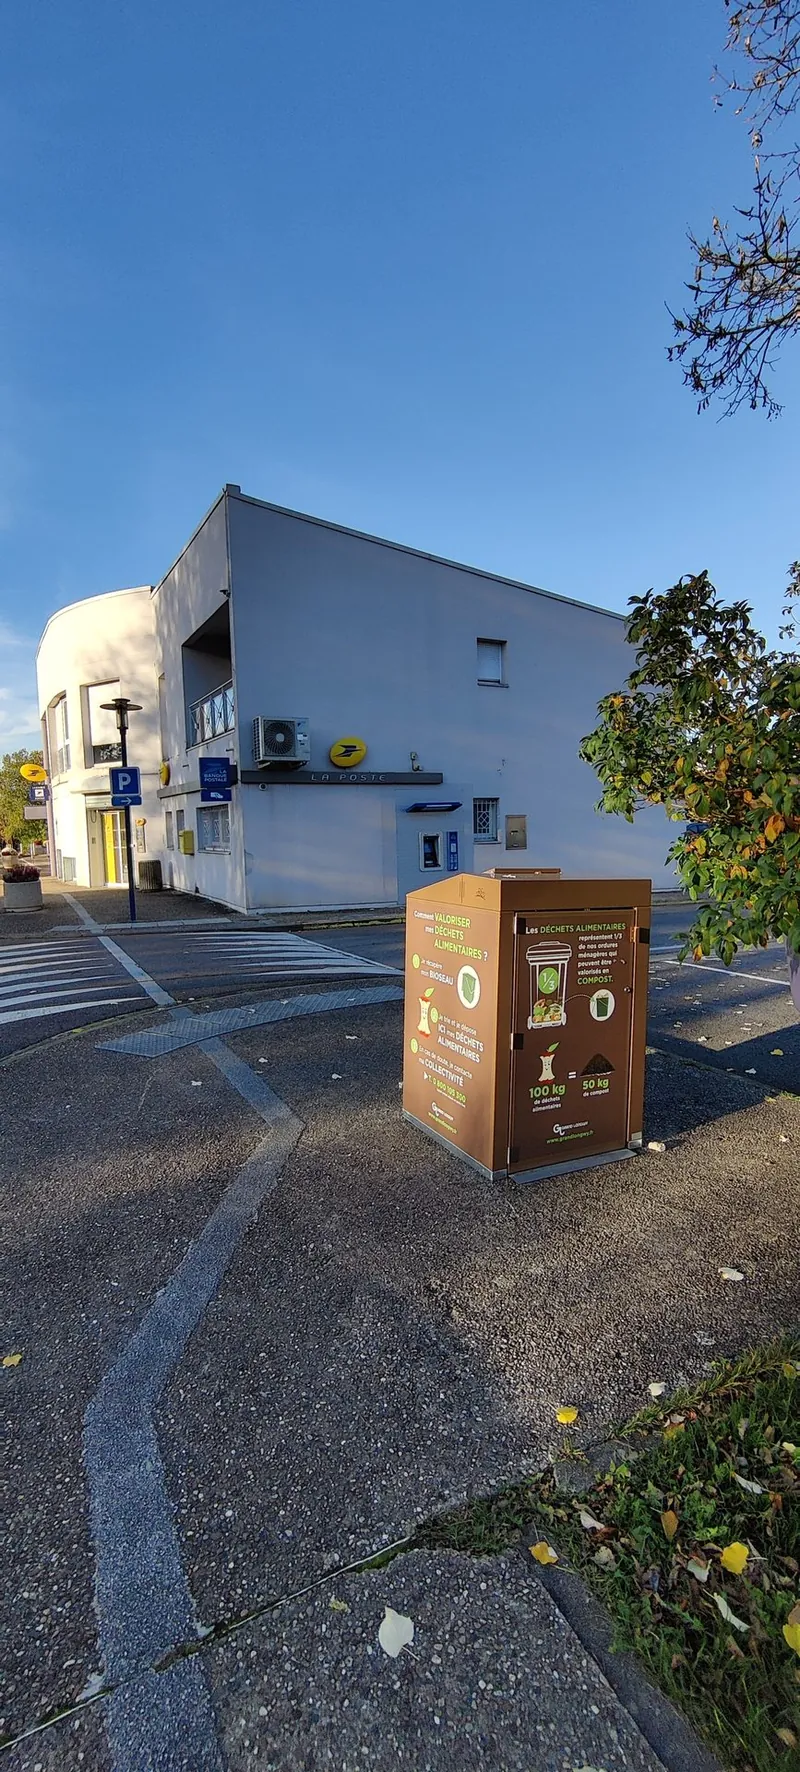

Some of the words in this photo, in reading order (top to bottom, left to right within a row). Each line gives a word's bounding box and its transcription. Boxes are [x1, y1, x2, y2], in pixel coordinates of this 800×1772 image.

[118, 772, 131, 790] P
[414, 910, 434, 920] Comment
[434, 912, 471, 928] VALORISER
[425, 926, 434, 934] mes
[434, 925, 464, 940] DÉCHETS
[526, 926, 538, 934] Les
[540, 924, 574, 934] DÉCHETS
[576, 922, 626, 932] ALIMENTAIRES
[578, 934, 612, 942] représentent
[434, 938, 482, 960] ALIMENTAIRES
[484, 951, 488, 962] ?
[578, 950, 608, 958] ménagères
[578, 960, 600, 968] peuvent
[430, 970, 454, 986] BIOSEAU
[578, 968, 601, 976] valorisés
[578, 976, 614, 985] COMPOST.
[438, 1023, 446, 1034] ICI
[456, 1031, 484, 1052] DÉCHETS
[438, 1036, 480, 1063] ALIMENTAIRES
[424, 1058, 464, 1087] COLLECTIVITÉ
[582, 1080, 596, 1090] 50
[597, 1078, 609, 1088] kg
[529, 1085, 550, 1098] 100
[552, 1084, 566, 1096] kg
[590, 1088, 610, 1096] compost
[542, 1096, 560, 1104] déchets
[532, 1102, 562, 1112] alimentaires
